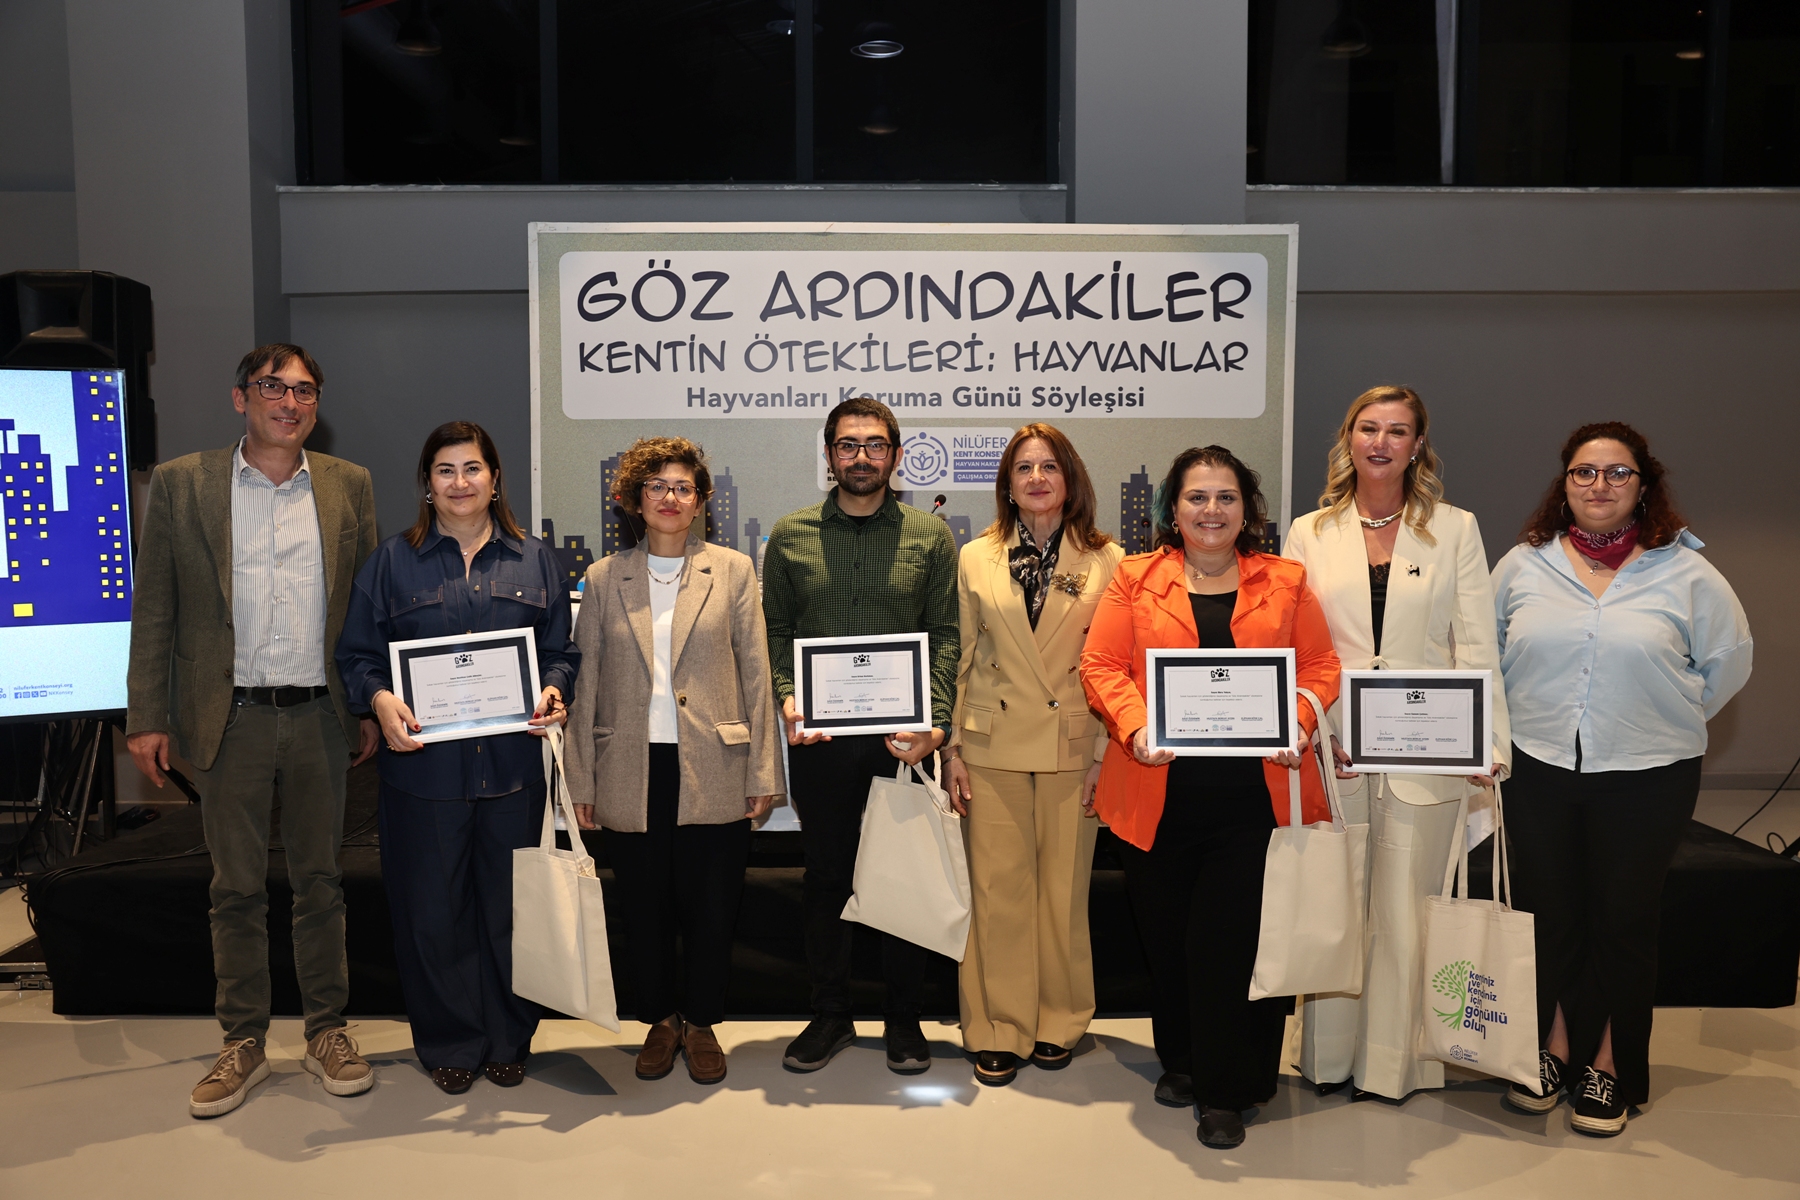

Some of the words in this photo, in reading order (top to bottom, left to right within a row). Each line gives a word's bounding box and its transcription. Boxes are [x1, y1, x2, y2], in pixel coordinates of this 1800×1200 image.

[577, 259, 734, 323] GÖZ
[760, 260, 1252, 323] ARDINDAKİLER
[579, 334, 726, 374] KENTİN
[744, 332, 995, 373] ÖTEKİLERİ:
[1014, 340, 1249, 373] HAYVANLAR
[687, 386, 827, 414] Hayvanları
[952, 386, 1021, 407] Günü
[1031, 385, 1144, 413] Söyleşisi
[953, 434, 1007, 449] NİLÜFER
[1471, 980, 1481, 988] ve
[1465, 1005, 1508, 1025] gönüllü
[1463, 1018, 1486, 1040] olun
